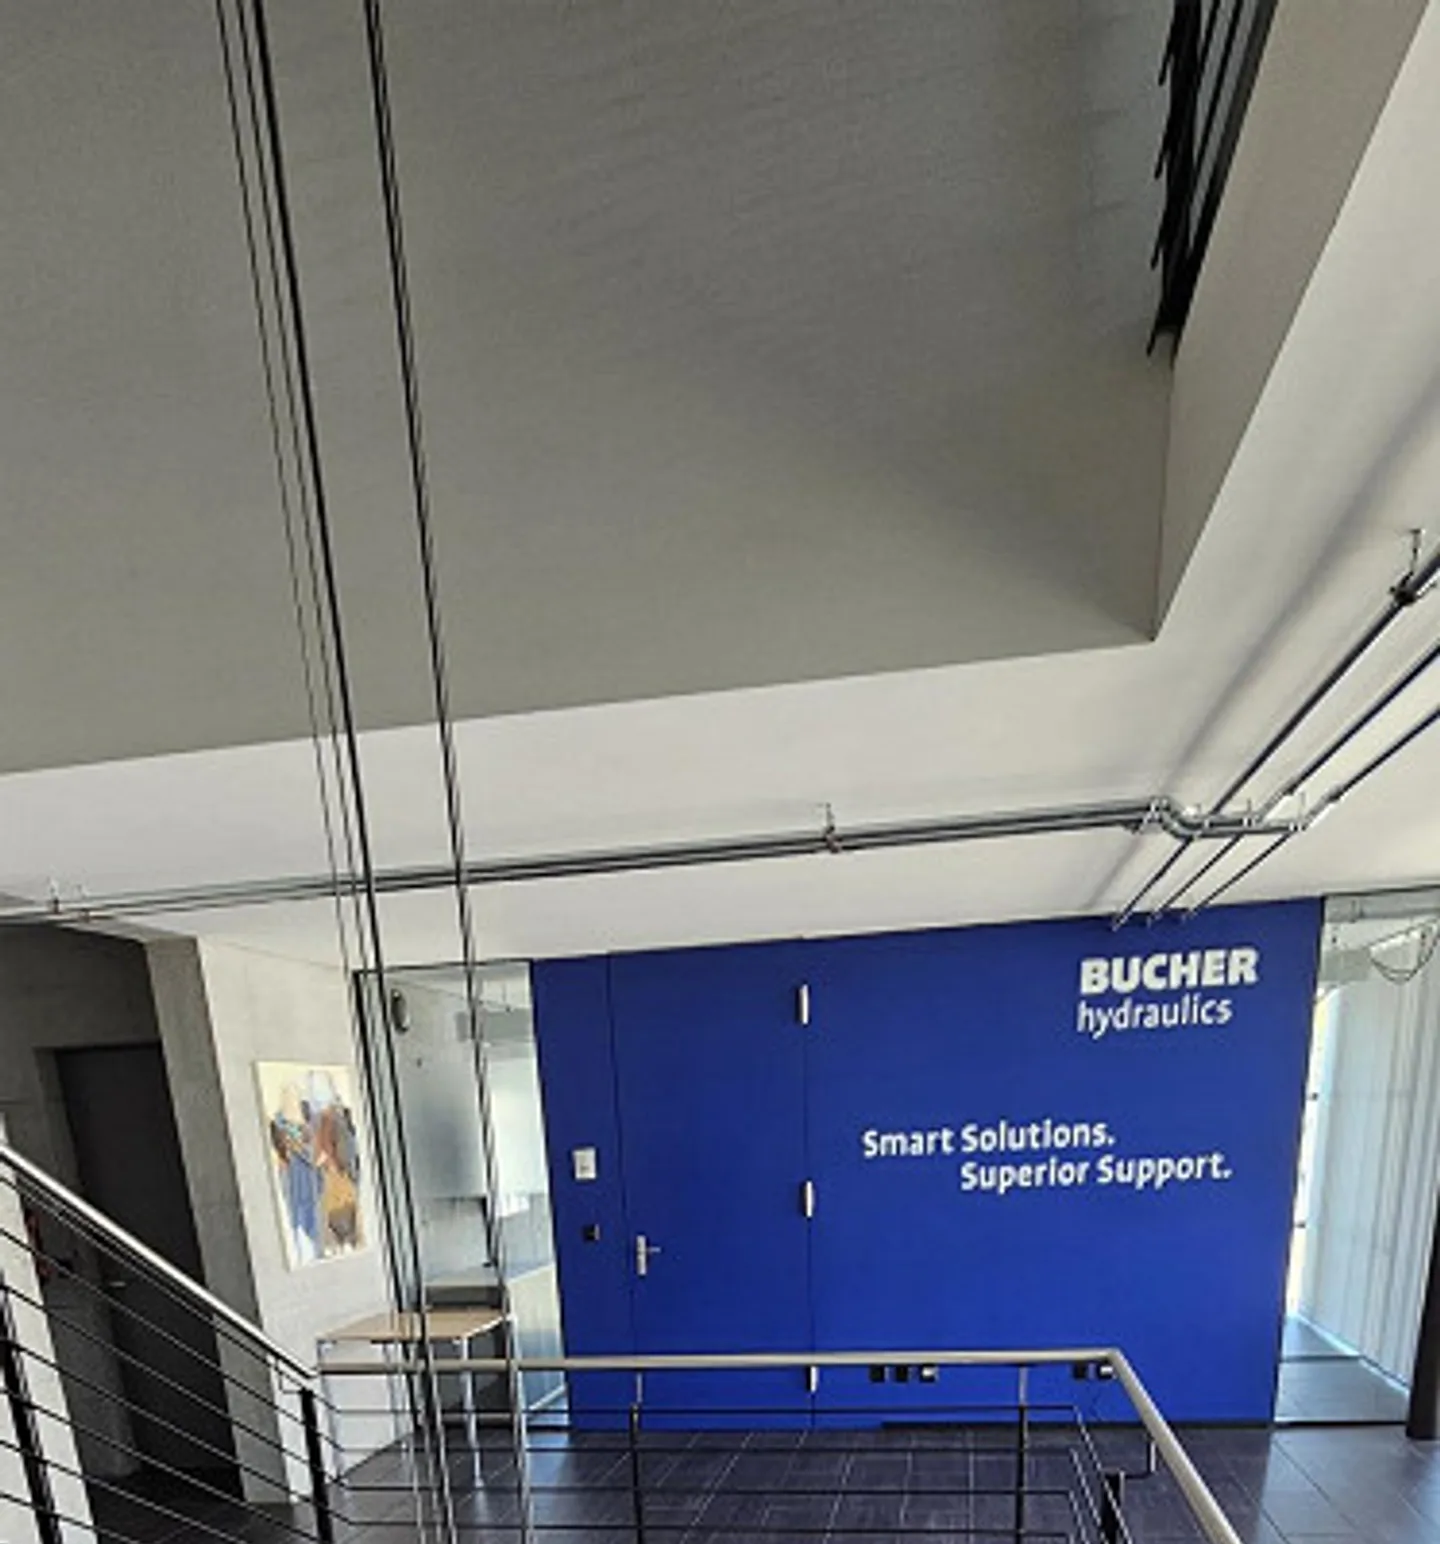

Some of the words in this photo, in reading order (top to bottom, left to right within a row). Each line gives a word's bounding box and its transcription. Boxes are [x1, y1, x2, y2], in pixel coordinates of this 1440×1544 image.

[1080, 947, 1258, 996] BUCHER
[1077, 993, 1233, 1040] hydraulics
[861, 1127, 954, 1158] Smart
[960, 1118, 1115, 1153] Solutions.
[960, 1156, 1090, 1195] Superior
[1096, 1153, 1233, 1189] Support.
